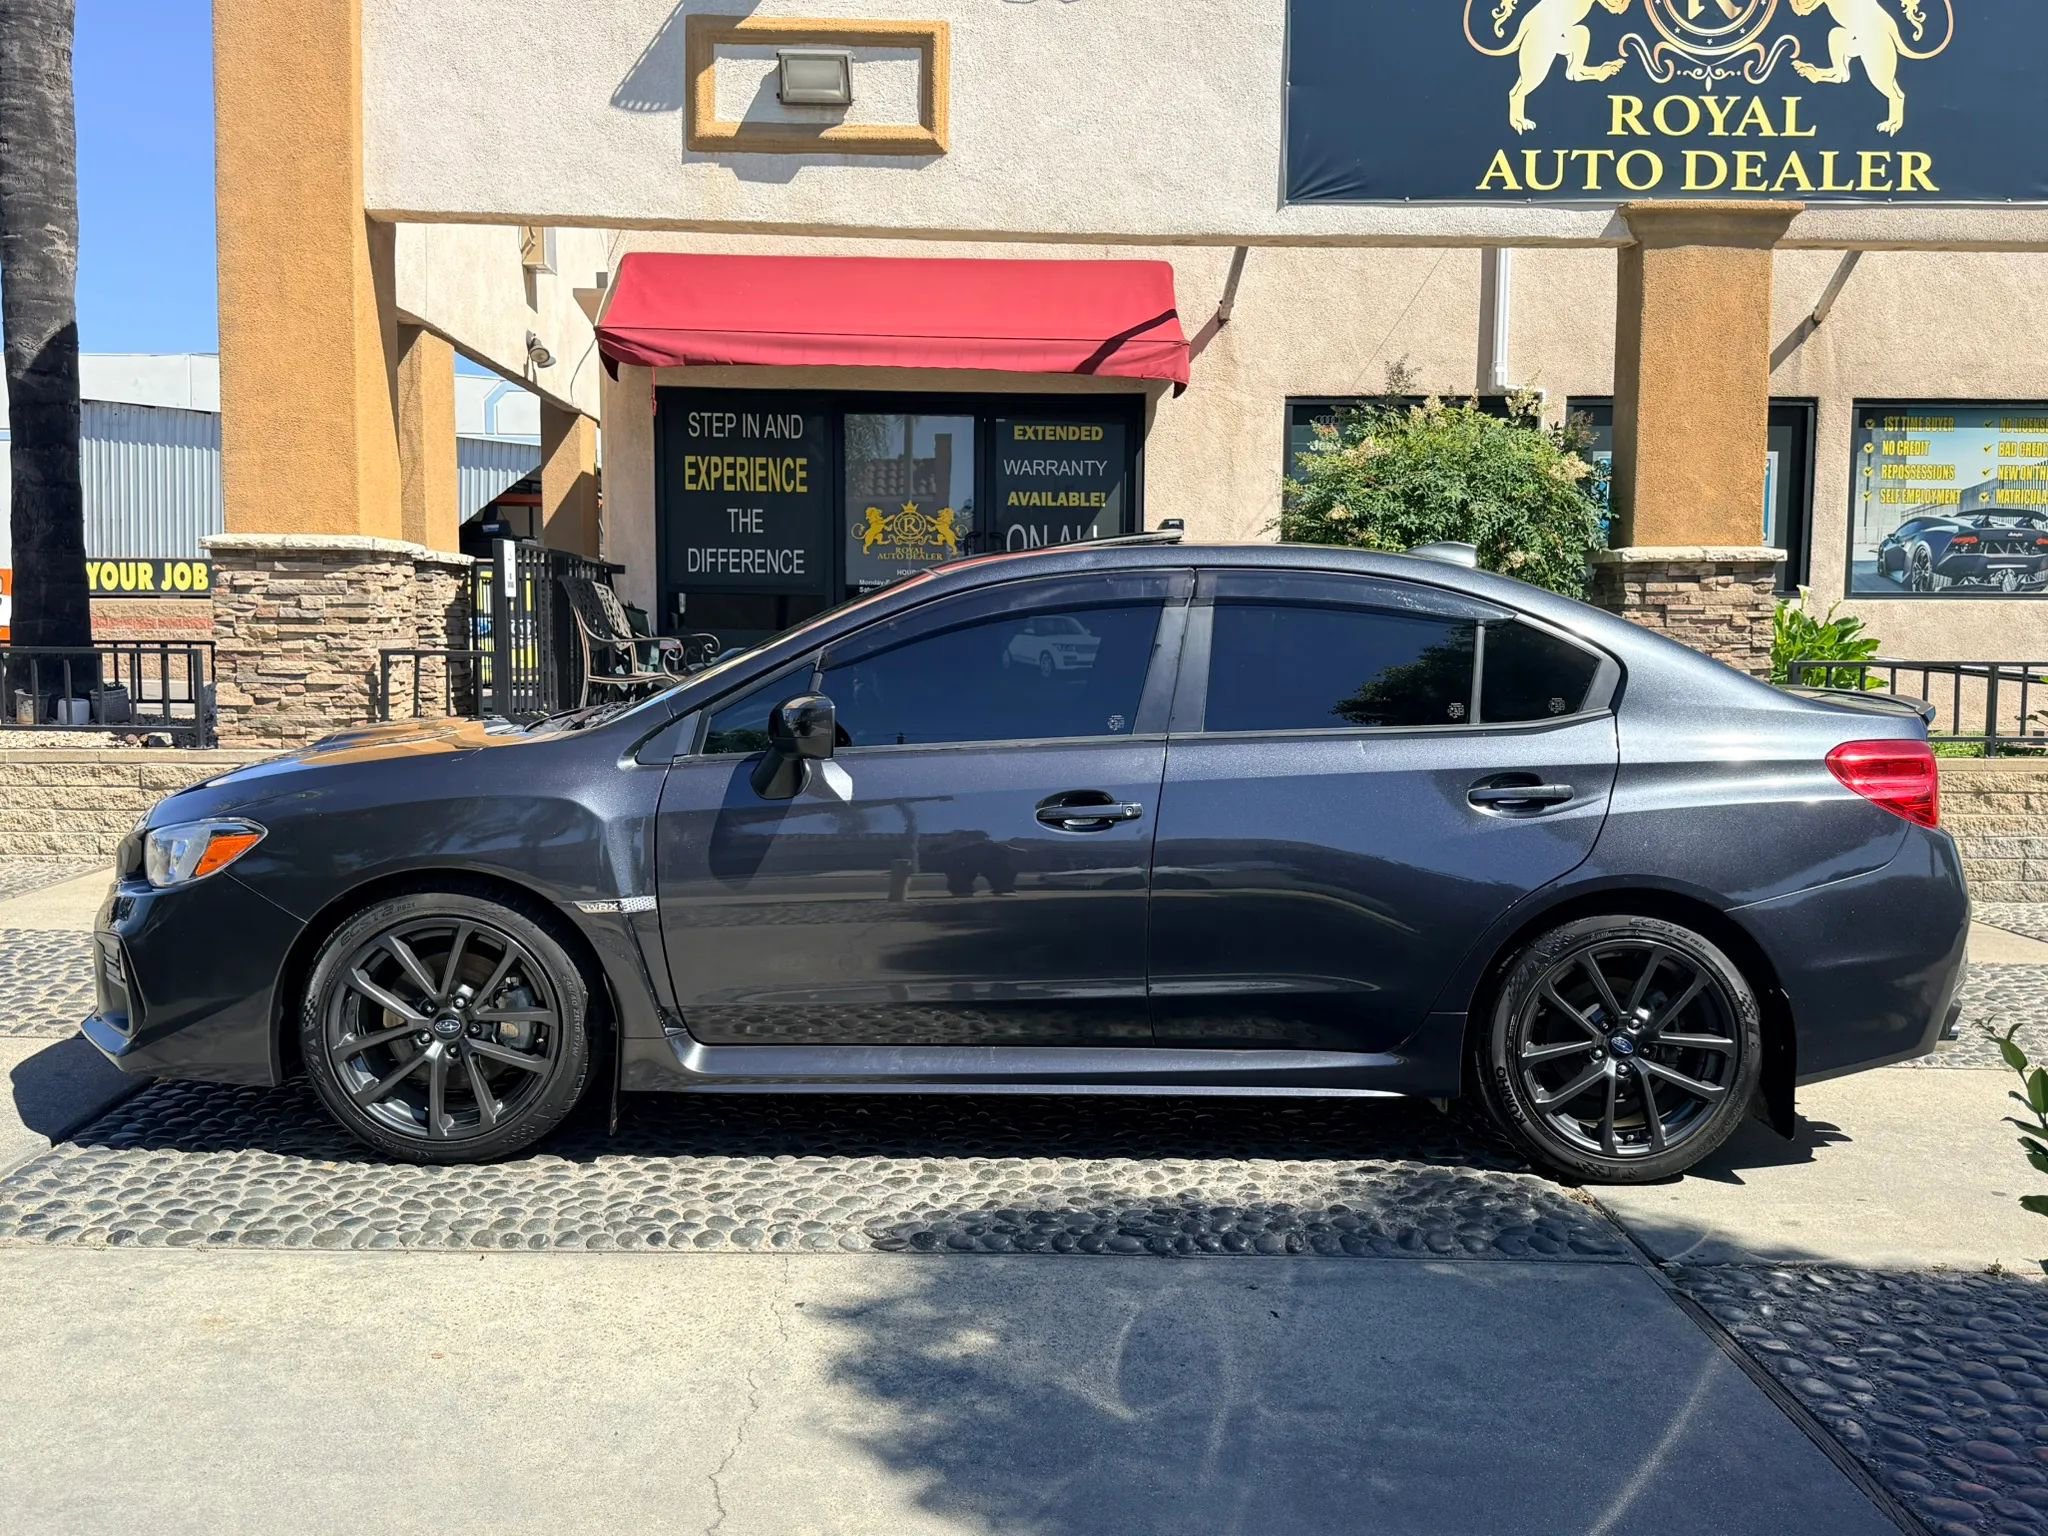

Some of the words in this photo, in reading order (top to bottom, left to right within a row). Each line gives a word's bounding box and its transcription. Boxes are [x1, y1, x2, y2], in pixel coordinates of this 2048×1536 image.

[1607, 95, 1816, 137] ROYAL
[1475, 149, 1663, 191] AUTO
[1681, 150, 1940, 192] DEALER
[688, 412, 737, 437] STEP
[742, 413, 760, 438] IN
[764, 414, 803, 439] AND
[1014, 425, 1104, 440] EXTENDED
[1883, 416, 1899, 432] 1ST
[1902, 416, 1923, 432] TIME
[1926, 416, 1954, 432] BUYER
[1882, 440, 1895, 456] NO
[1897, 440, 1930, 456] CREDIT
[1998, 441, 2017, 457] BAD
[684, 455, 808, 493] EXPERIENCE
[1003, 459, 1108, 476] WARRANTY
[1881, 464, 1955, 480] REPOSSESSIONS
[1998, 465, 2019, 480] NEW
[2020, 465, 2033, 480] ON
[2034, 465, 2048, 480] TH
[1007, 491, 1106, 508] AVAILABLE!
[1880, 488, 1900, 504] SELF
[1902, 488, 1961, 504] EMPLOYMENT
[726, 508, 764, 533] THE
[688, 548, 805, 574] DIFFERENCE
[86, 561, 154, 591] YOUR
[160, 562, 209, 591] JOB
[586, 902, 619, 911] WRX
